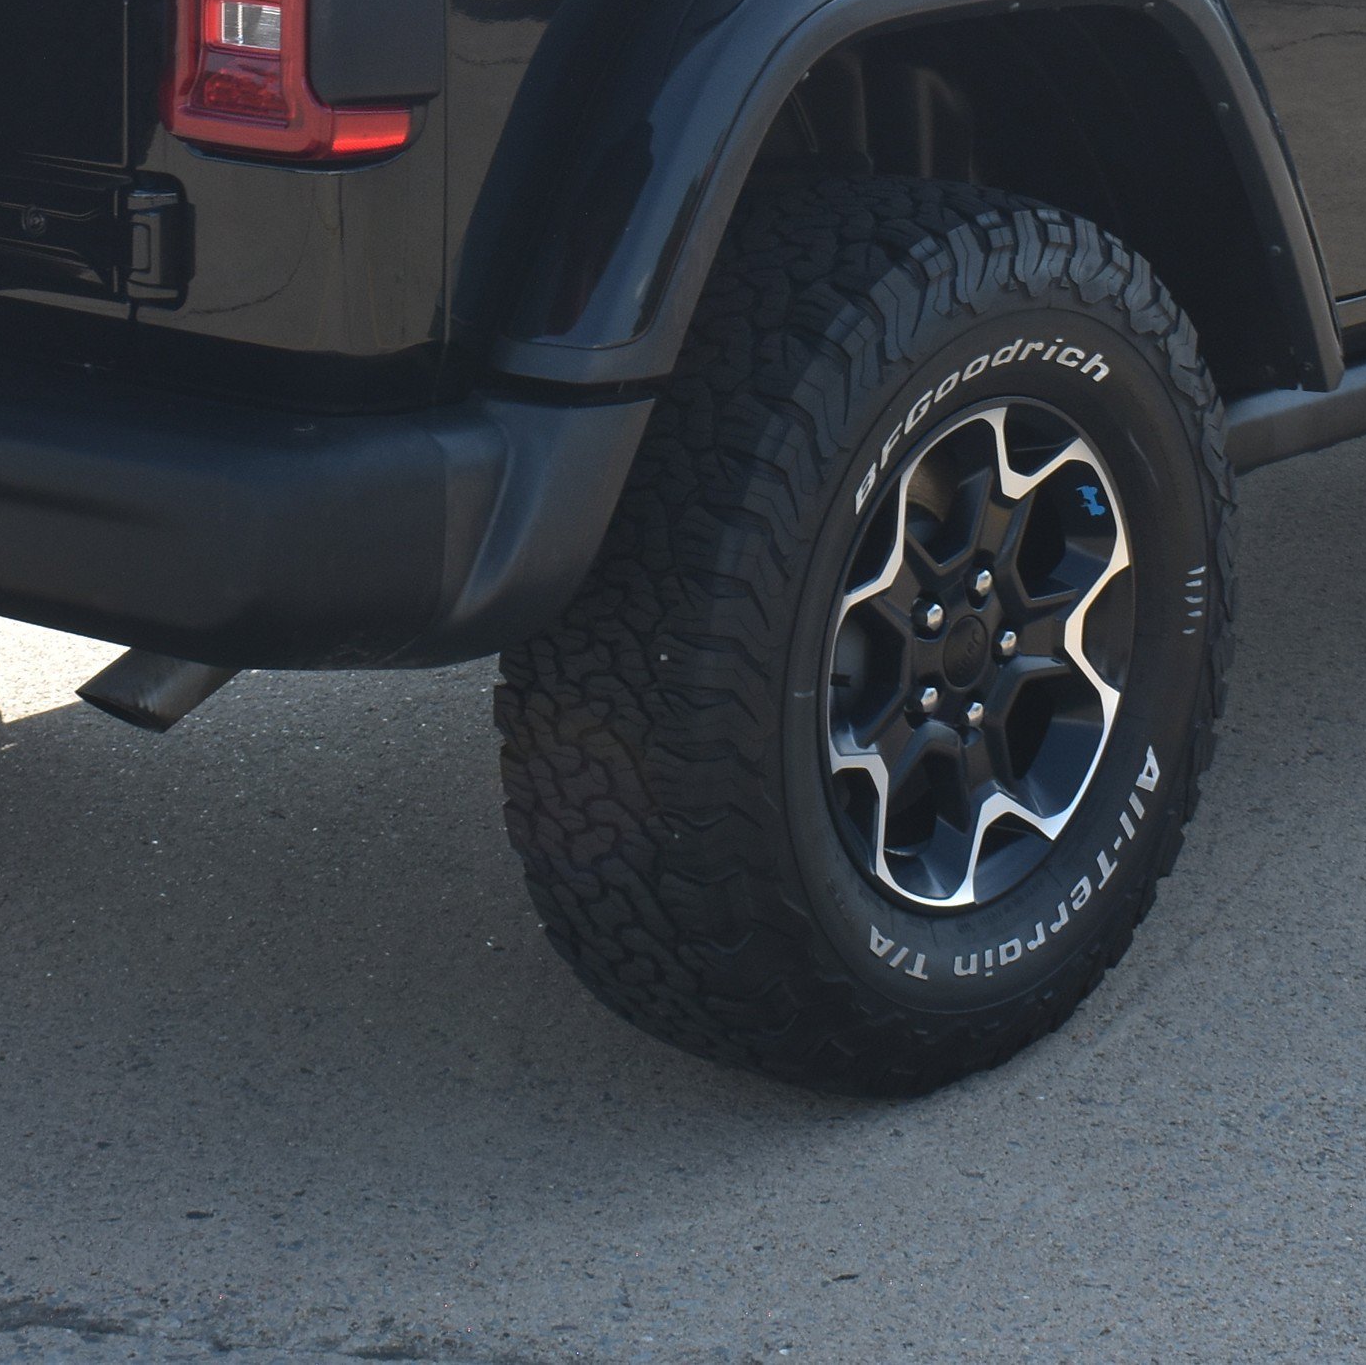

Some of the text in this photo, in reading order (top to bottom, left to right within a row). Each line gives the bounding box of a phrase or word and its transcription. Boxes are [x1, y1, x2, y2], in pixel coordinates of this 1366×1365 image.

[855, 338, 1110, 515] BFGoodrich
[869, 745, 1160, 980] All-Terrain T/A
